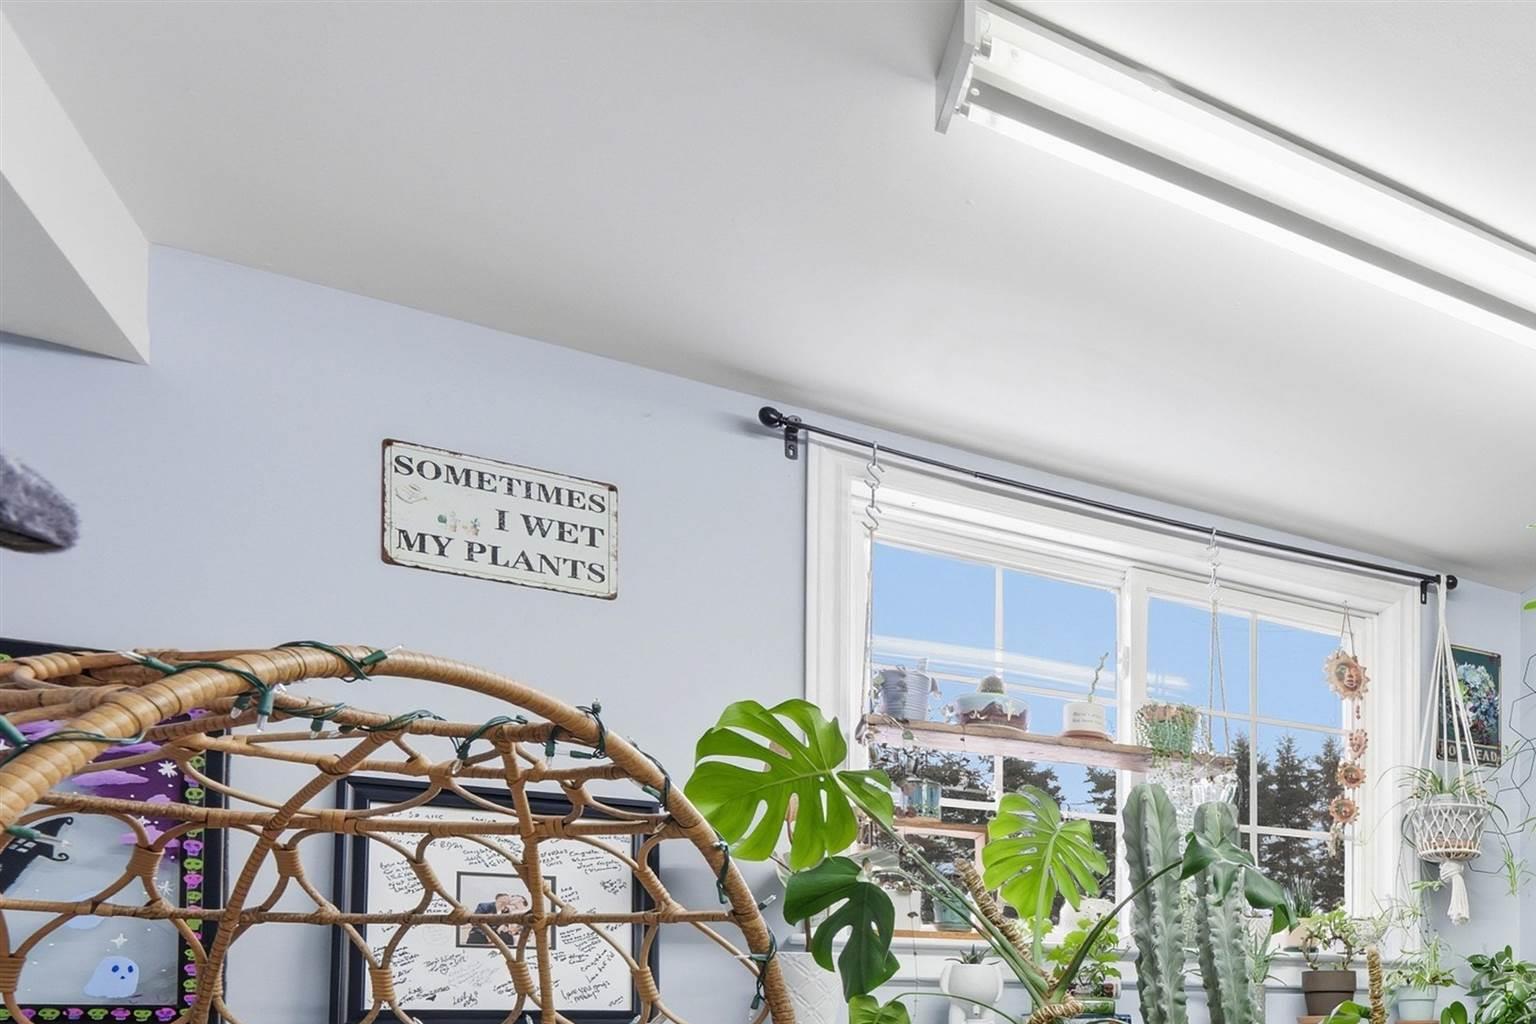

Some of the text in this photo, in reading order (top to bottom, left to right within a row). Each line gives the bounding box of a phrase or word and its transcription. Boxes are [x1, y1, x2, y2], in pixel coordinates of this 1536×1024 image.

[393, 454, 606, 514] SOMETIMES
[394, 527, 606, 584] MY PLANTS
[495, 508, 605, 549] I WET
